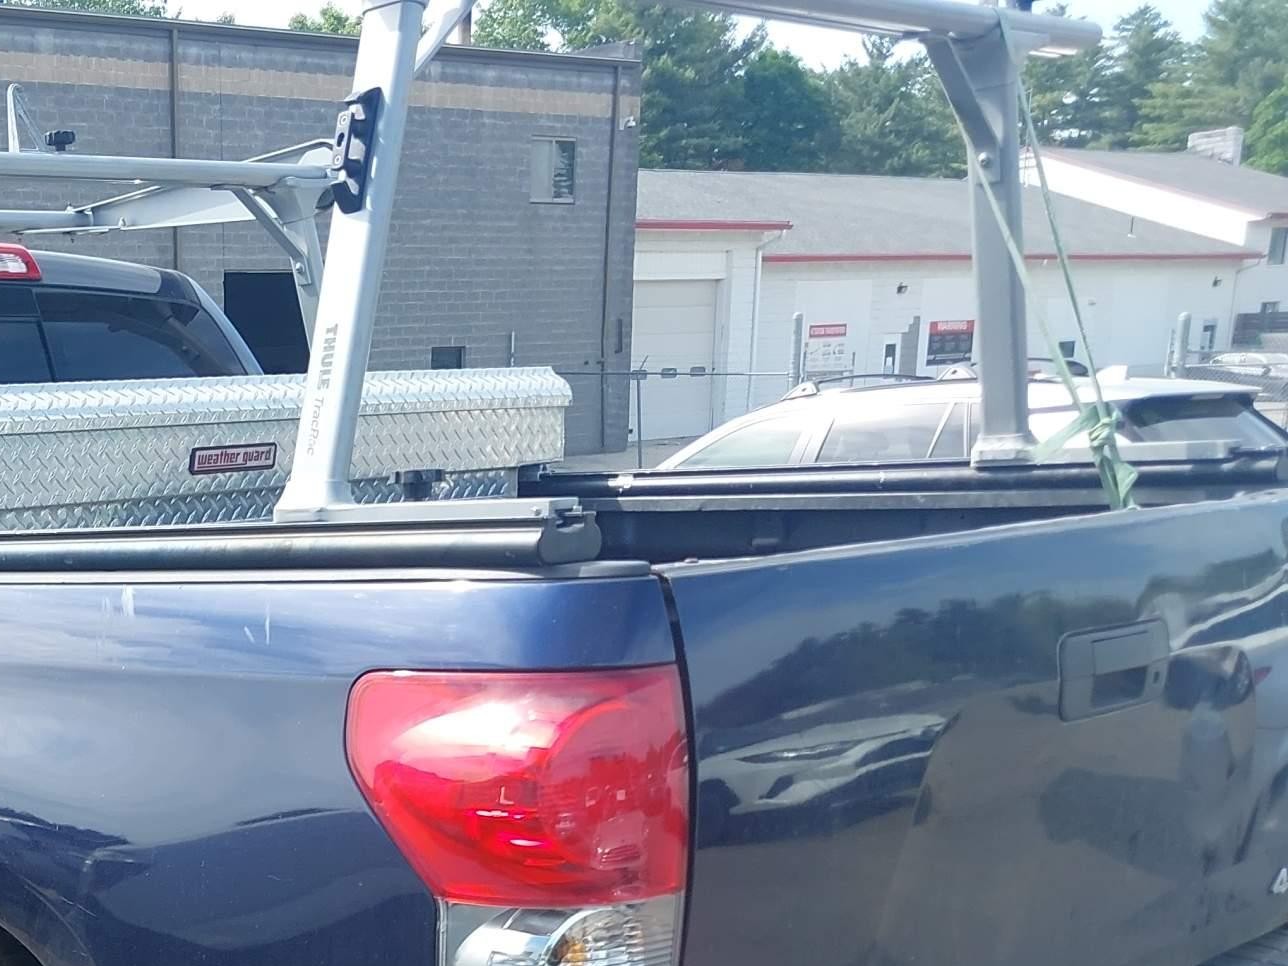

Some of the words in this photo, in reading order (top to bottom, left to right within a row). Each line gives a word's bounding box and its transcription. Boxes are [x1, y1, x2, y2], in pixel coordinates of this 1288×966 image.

[316, 323, 339, 391] THULE
[197, 450, 240, 466] weather
[242, 447, 272, 465] guard
